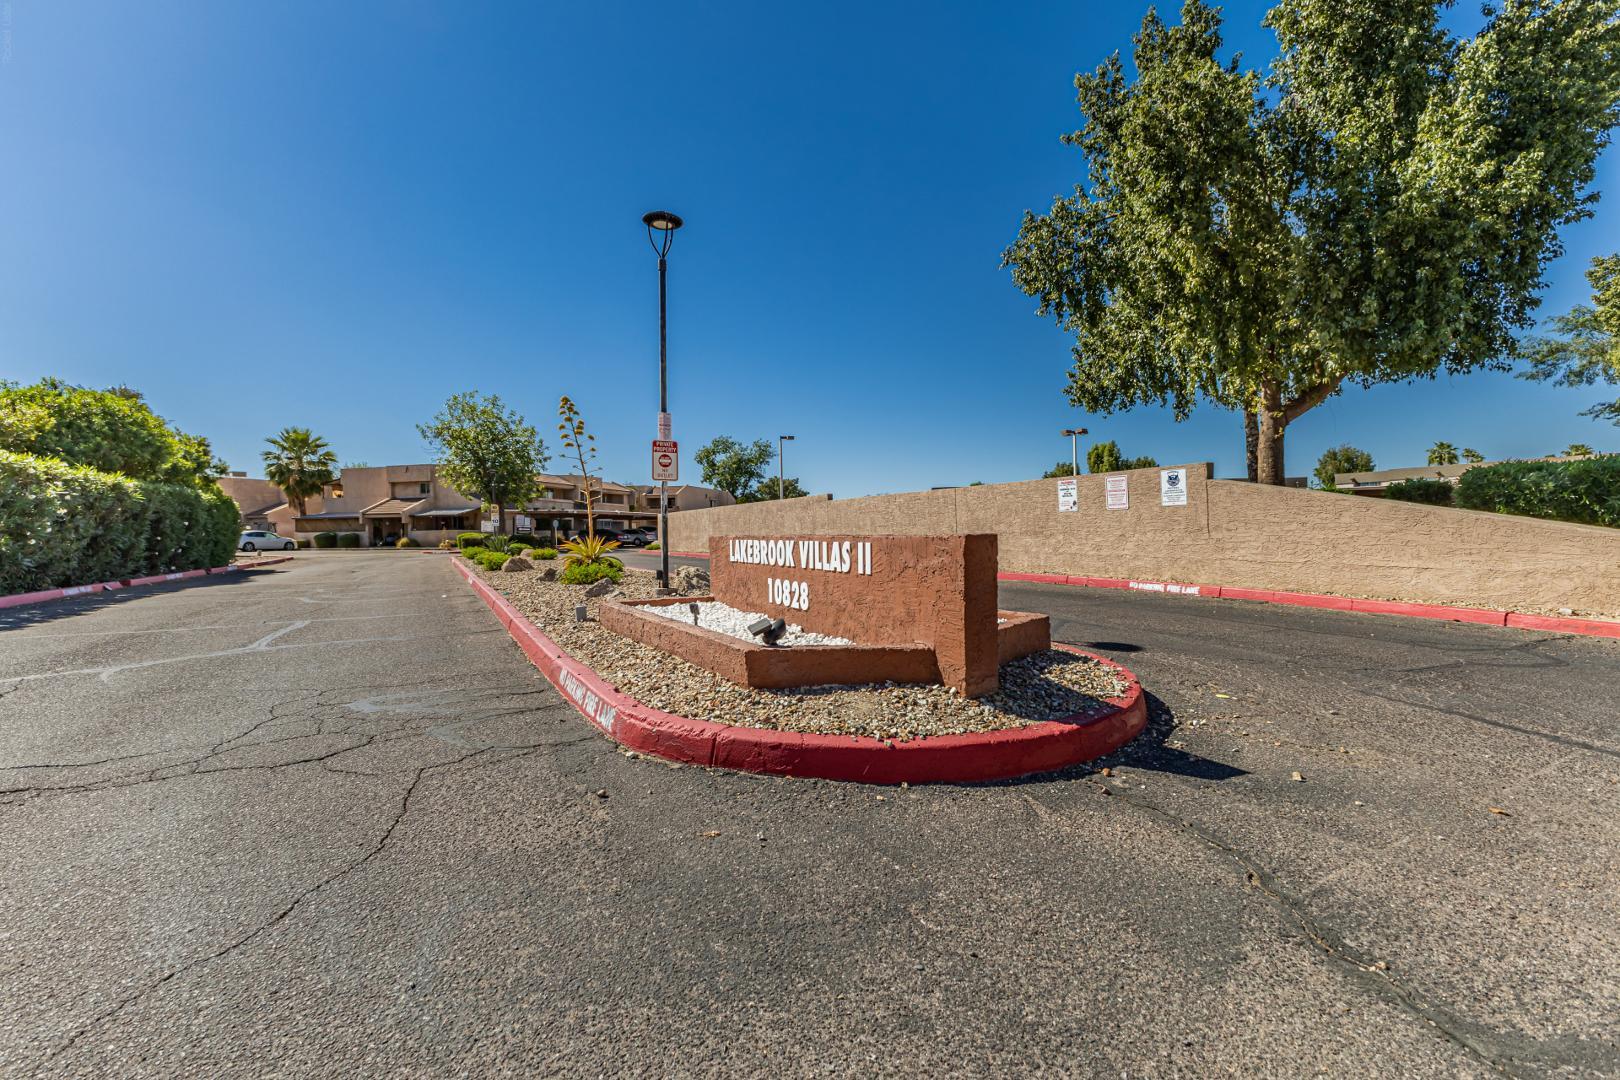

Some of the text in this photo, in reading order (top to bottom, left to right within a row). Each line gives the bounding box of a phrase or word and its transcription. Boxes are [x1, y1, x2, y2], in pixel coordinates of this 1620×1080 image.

[729, 539, 872, 575] LAKEBROOK VILLAS II
[767, 577, 809, 611] 10828
[1181, 586, 1200, 596] LANE
